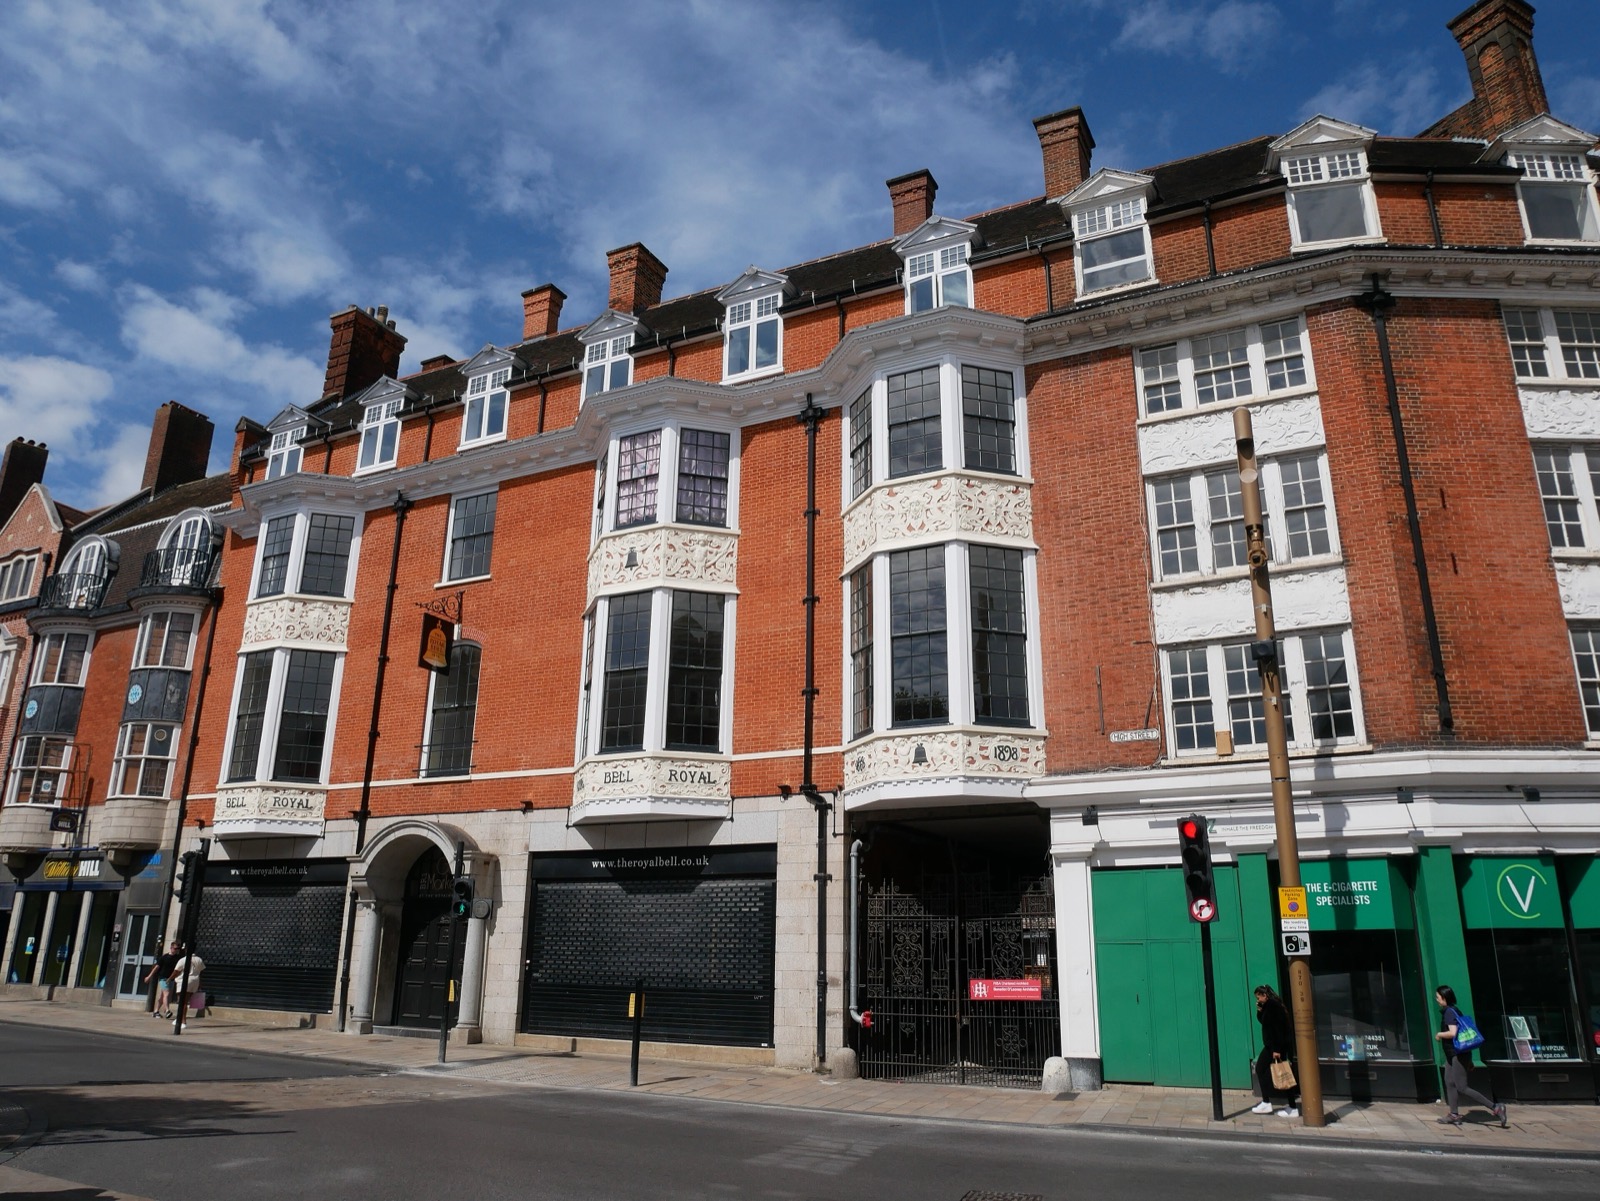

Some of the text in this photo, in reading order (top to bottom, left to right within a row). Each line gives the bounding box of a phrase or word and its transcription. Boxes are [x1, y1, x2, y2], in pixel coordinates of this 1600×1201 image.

[1130, 730, 1155, 739] STREET
[994, 745, 1018, 762] 1898
[603, 769, 717, 784] BELL ROYAL
[226, 796, 313, 809] BELL ROYAL
[78, 860, 100, 877] HILL
[591, 855, 709, 869] www.theroyalbell.co.uk
[230, 866, 308, 877] www.theroyalbell.co.uk
[1306, 881, 1378, 893] THE E-CIGARETTE
[1316, 895, 1371, 906] SPECIALISTS
